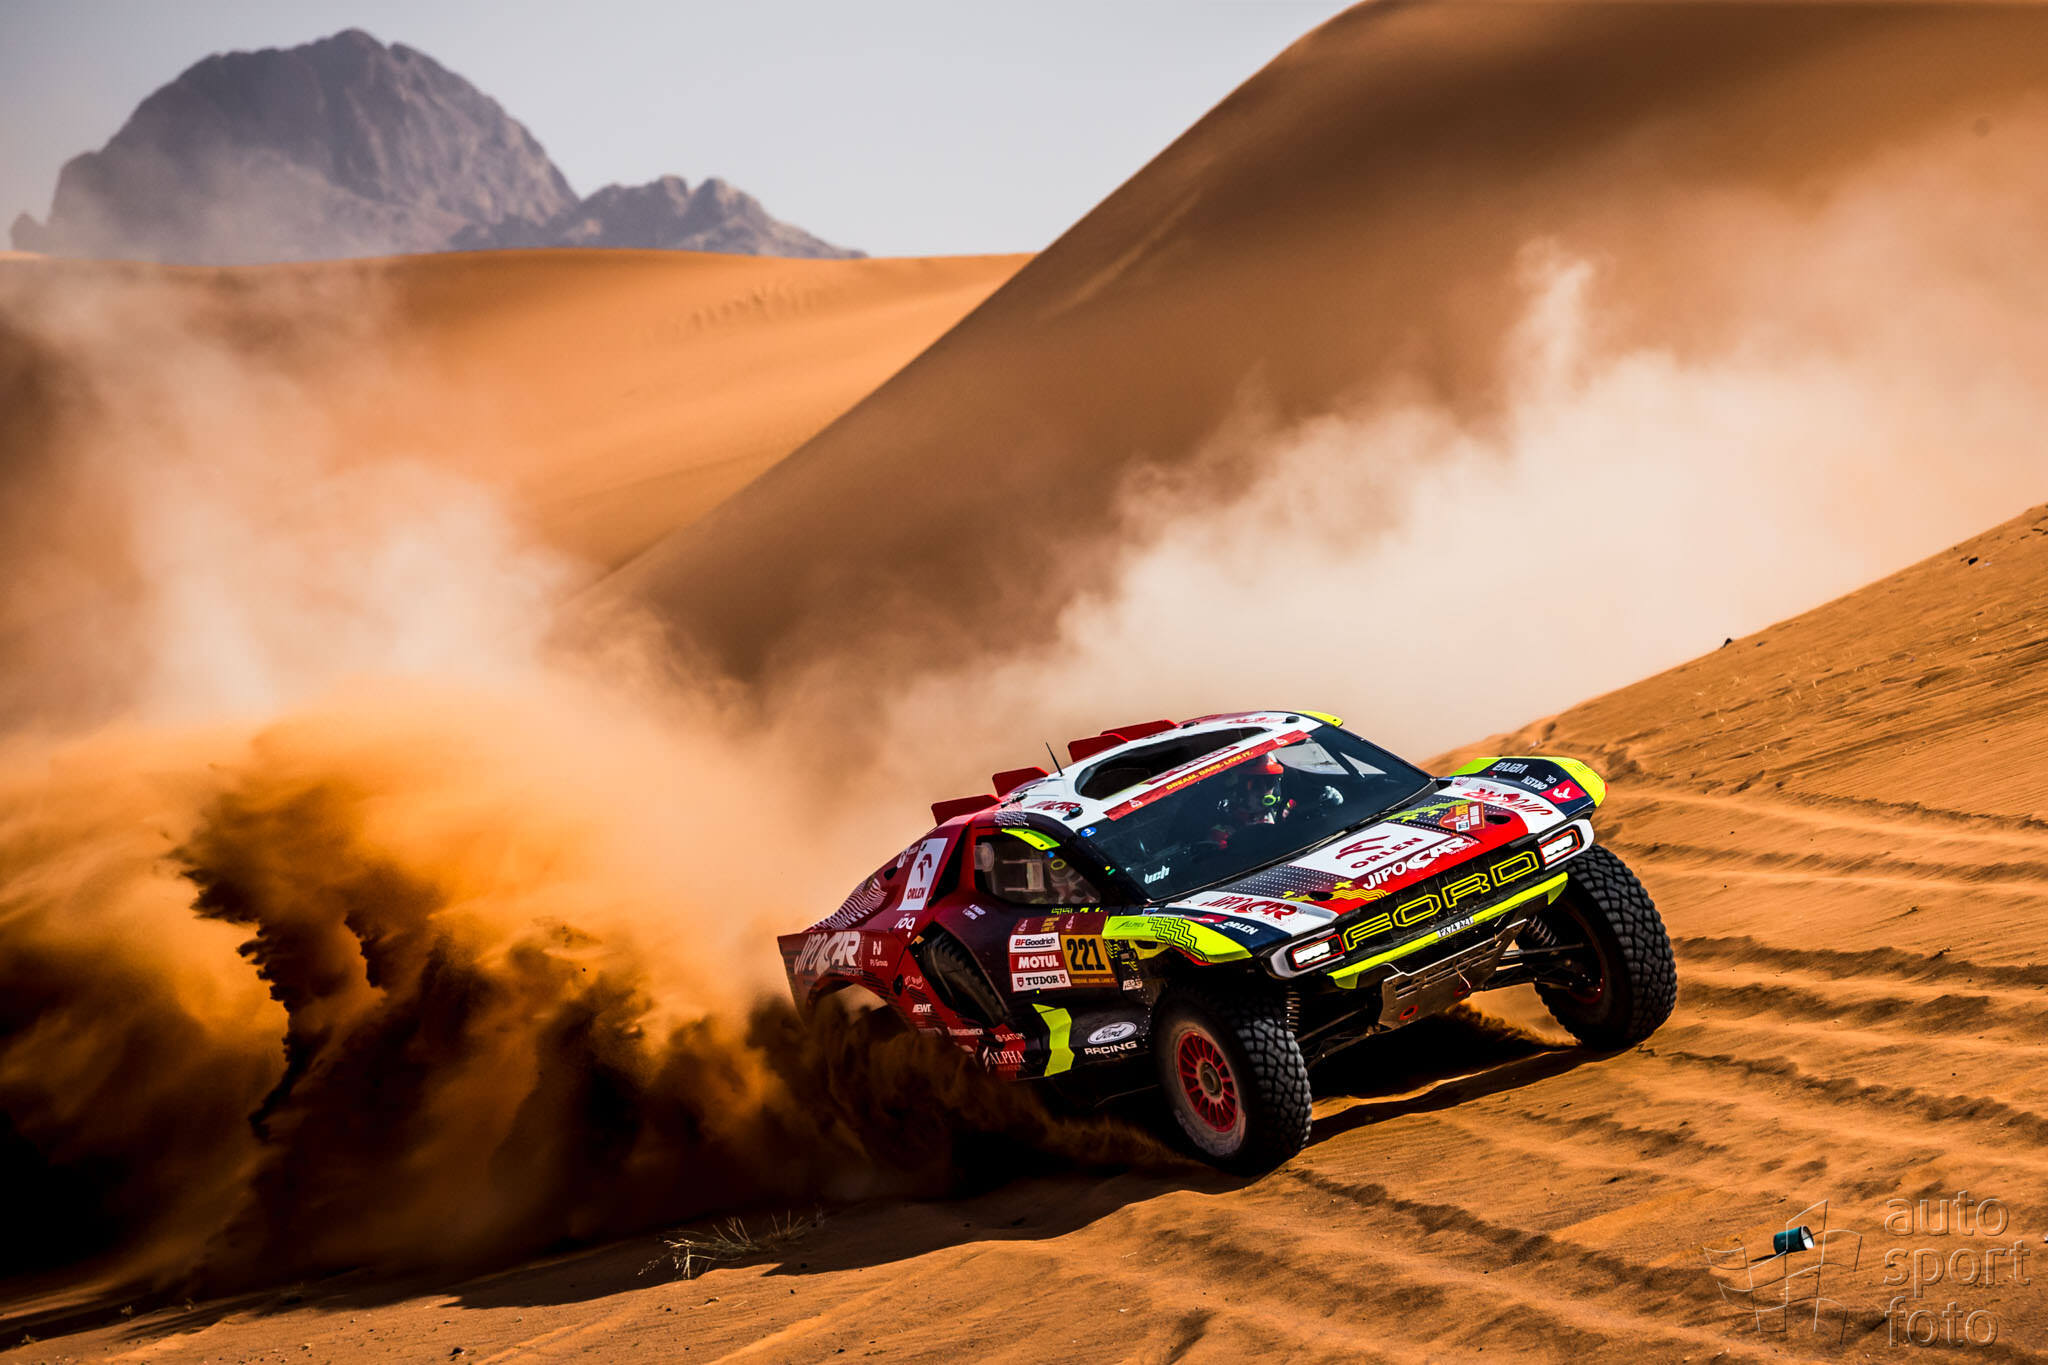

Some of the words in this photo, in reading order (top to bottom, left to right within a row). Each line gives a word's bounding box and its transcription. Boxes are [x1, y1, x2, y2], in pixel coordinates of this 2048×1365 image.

[1166, 774, 1198, 790] DREAM.
[1224, 755, 1242, 766] LIVE
[1521, 775, 1549, 791] ORLEN
[1350, 837, 1424, 869] ORLEN
[1363, 836, 1467, 891] JIPOCAR
[907, 886, 927, 900] ORLEN
[1342, 850, 1540, 952] FORD
[1223, 921, 1259, 936] ORLEN
[1014, 937, 1055, 946] BFGoodrich
[1018, 955, 1060, 969] MOTUL
[1066, 938, 1107, 971] 221
[1025, 975, 1060, 986] TUDOR
[1095, 1022, 1127, 1041] Ford
[1084, 1041, 1138, 1055] RACING
[989, 1050, 1026, 1065] ALPHA
